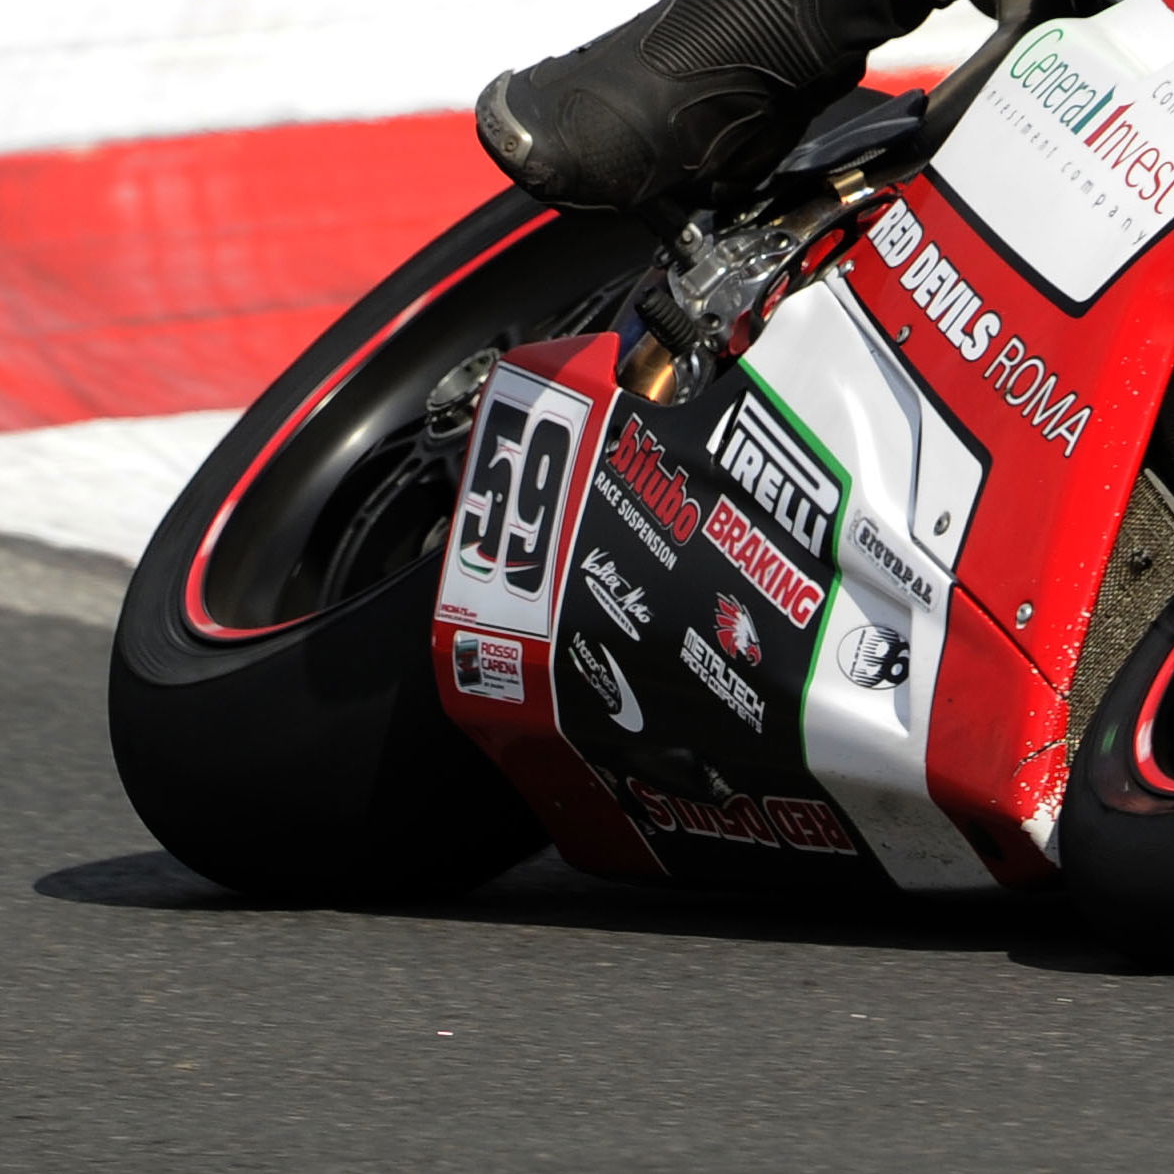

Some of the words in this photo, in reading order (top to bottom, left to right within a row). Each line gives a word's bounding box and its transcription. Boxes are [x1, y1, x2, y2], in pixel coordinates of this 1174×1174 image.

[1061, 160, 1149, 247] company
[866, 197, 924, 268] RED
[900, 241, 1001, 362] DEVILS
[982, 335, 1094, 458] ROMA
[459, 400, 573, 593] 59
[594, 471, 620, 509] RACE
[618, 499, 679, 572] SUSPENSION
[605, 413, 701, 546] bitubo
[706, 390, 841, 559] PIRELLI
[701, 494, 826, 630] BRAKING
[480, 641, 519, 661] ROSSO
[481, 657, 519, 677] CARENA
[683, 626, 766, 721] METALTECH
